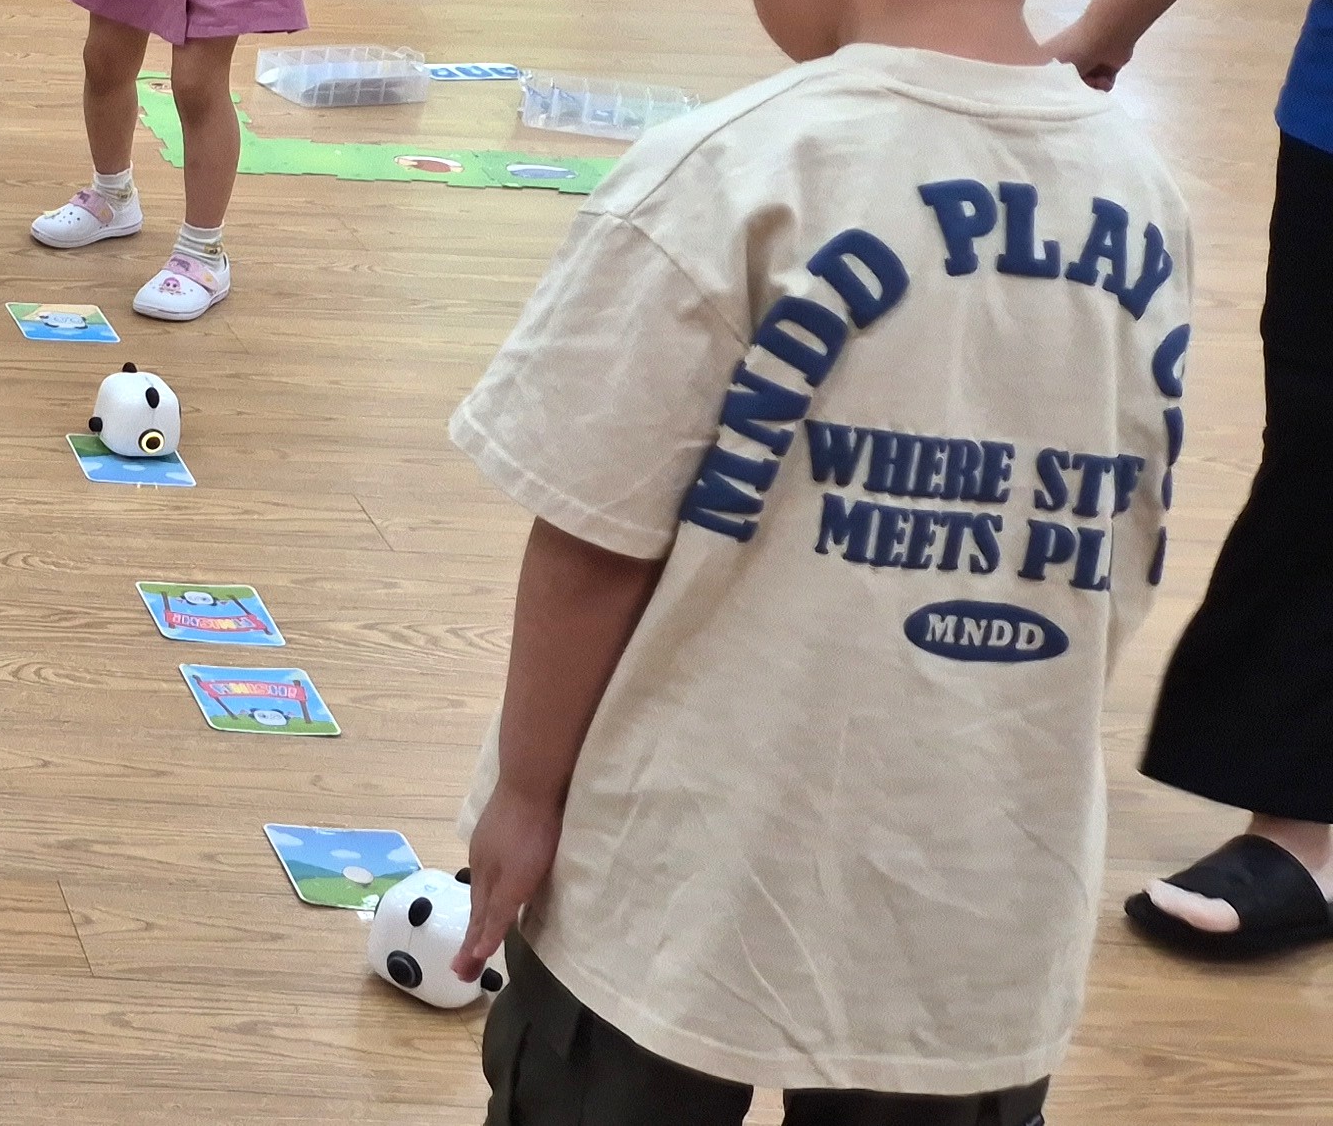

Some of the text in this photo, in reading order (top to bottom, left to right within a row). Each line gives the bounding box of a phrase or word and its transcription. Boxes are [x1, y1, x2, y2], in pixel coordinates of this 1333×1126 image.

[679, 228, 911, 543] MNDD
[918, 178, 1174, 321] PLAY
[803, 419, 1016, 504] WHERE
[815, 492, 1004, 575] MEETS
[924, 613, 1046, 651] MNDD
